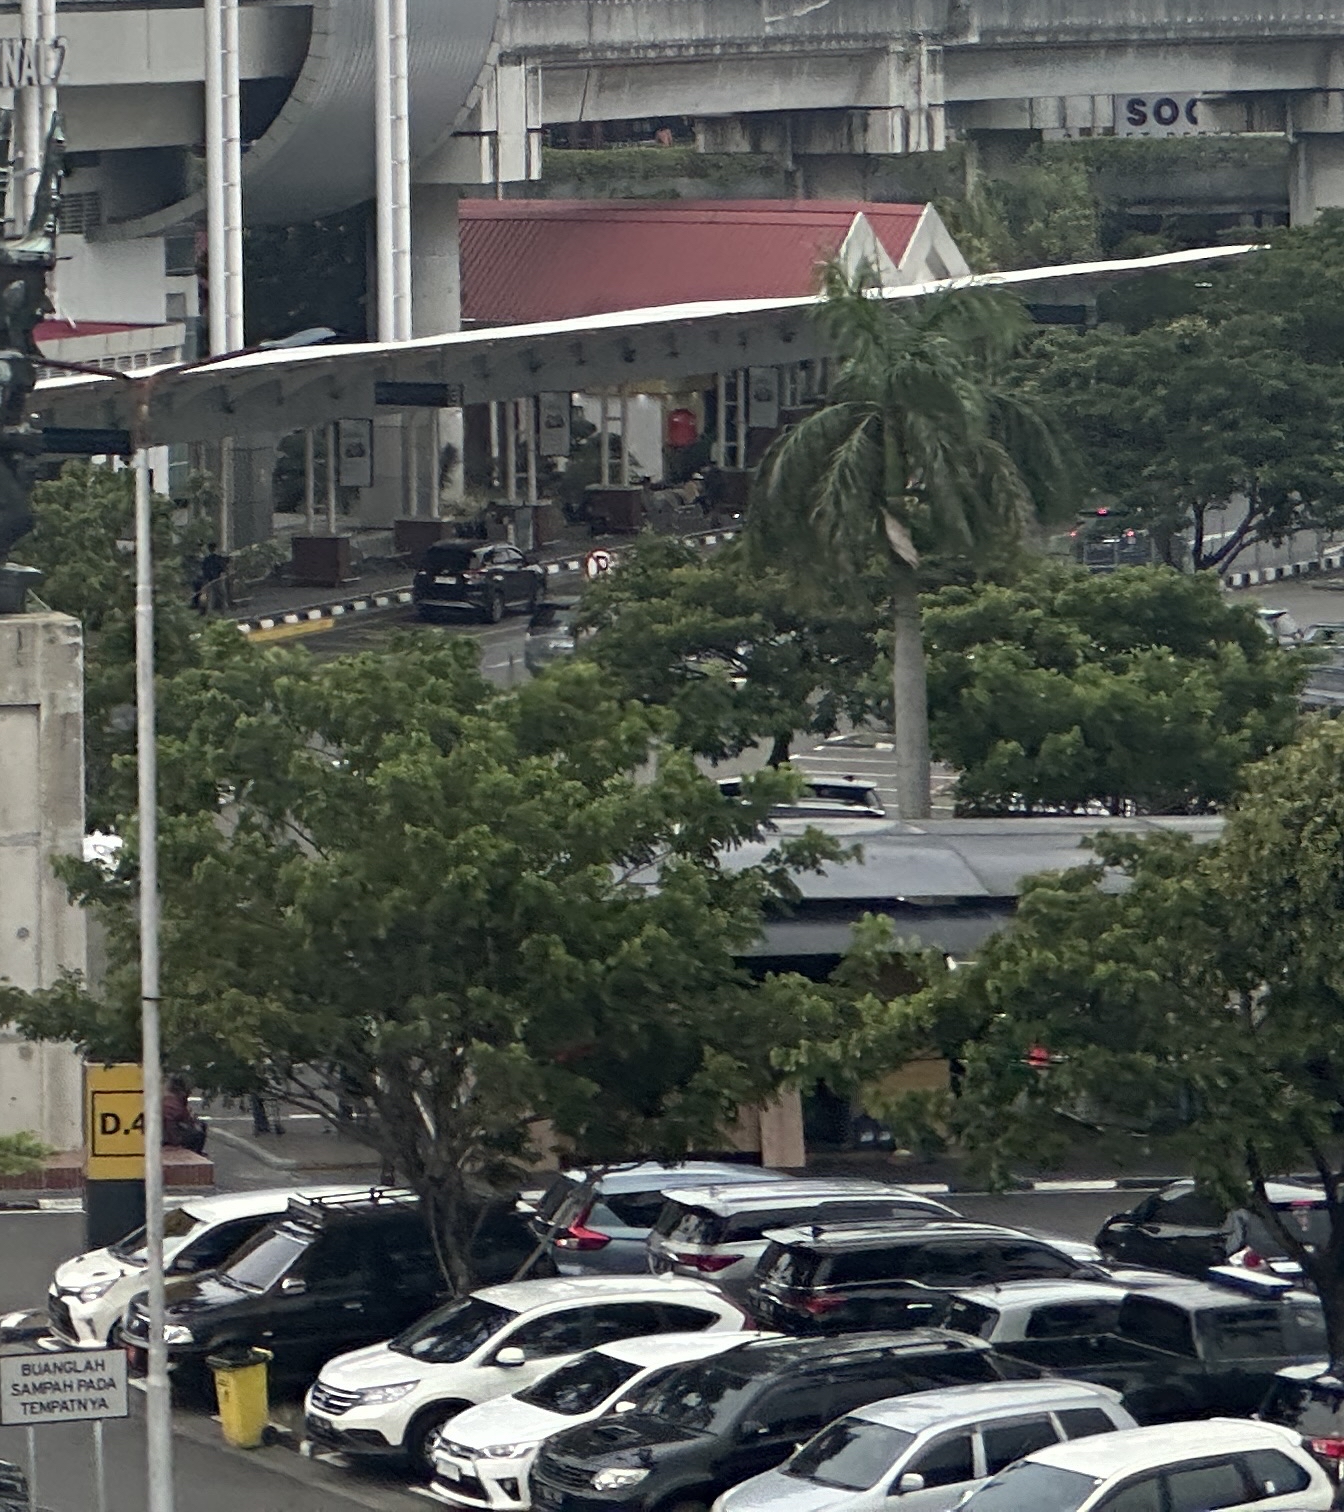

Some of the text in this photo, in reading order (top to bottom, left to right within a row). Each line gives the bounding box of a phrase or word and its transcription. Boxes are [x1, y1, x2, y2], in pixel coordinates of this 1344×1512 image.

[100, 1112, 146, 1136] D.4
[21, 1359, 106, 1377] BUANGLAH
[11, 1377, 117, 1396] SAMPAH PADA
[20, 1397, 110, 1416] TEMPATNYA
